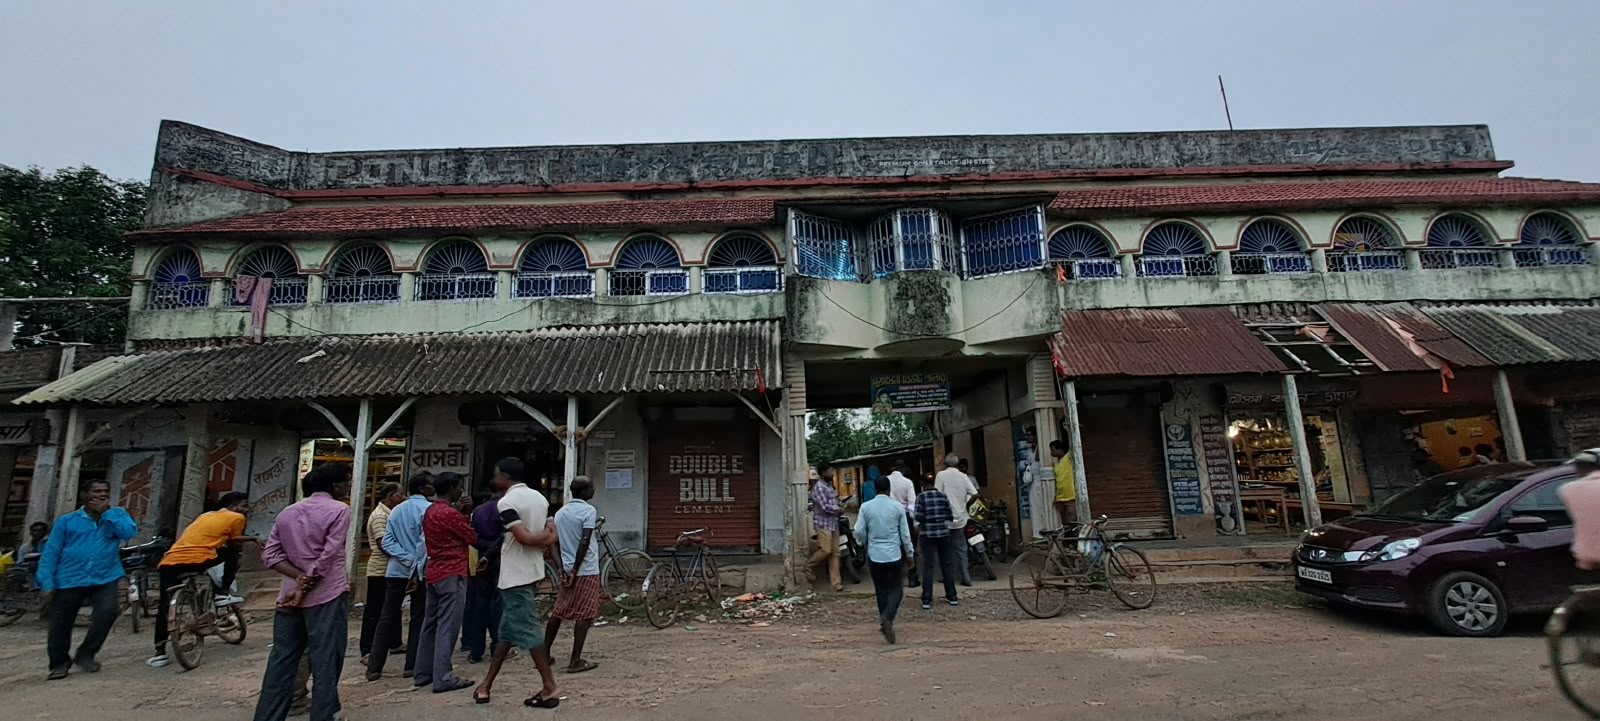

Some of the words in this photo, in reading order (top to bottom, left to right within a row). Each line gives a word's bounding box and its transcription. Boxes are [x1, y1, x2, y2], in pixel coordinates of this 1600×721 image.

[913, 159, 973, 167] CONSTRUCTION
[412, 443, 470, 467] বাসন্তী
[669, 455, 744, 475] DOUBLE
[679, 478, 735, 502] BULL
[675, 505, 733, 514] CEMENT
